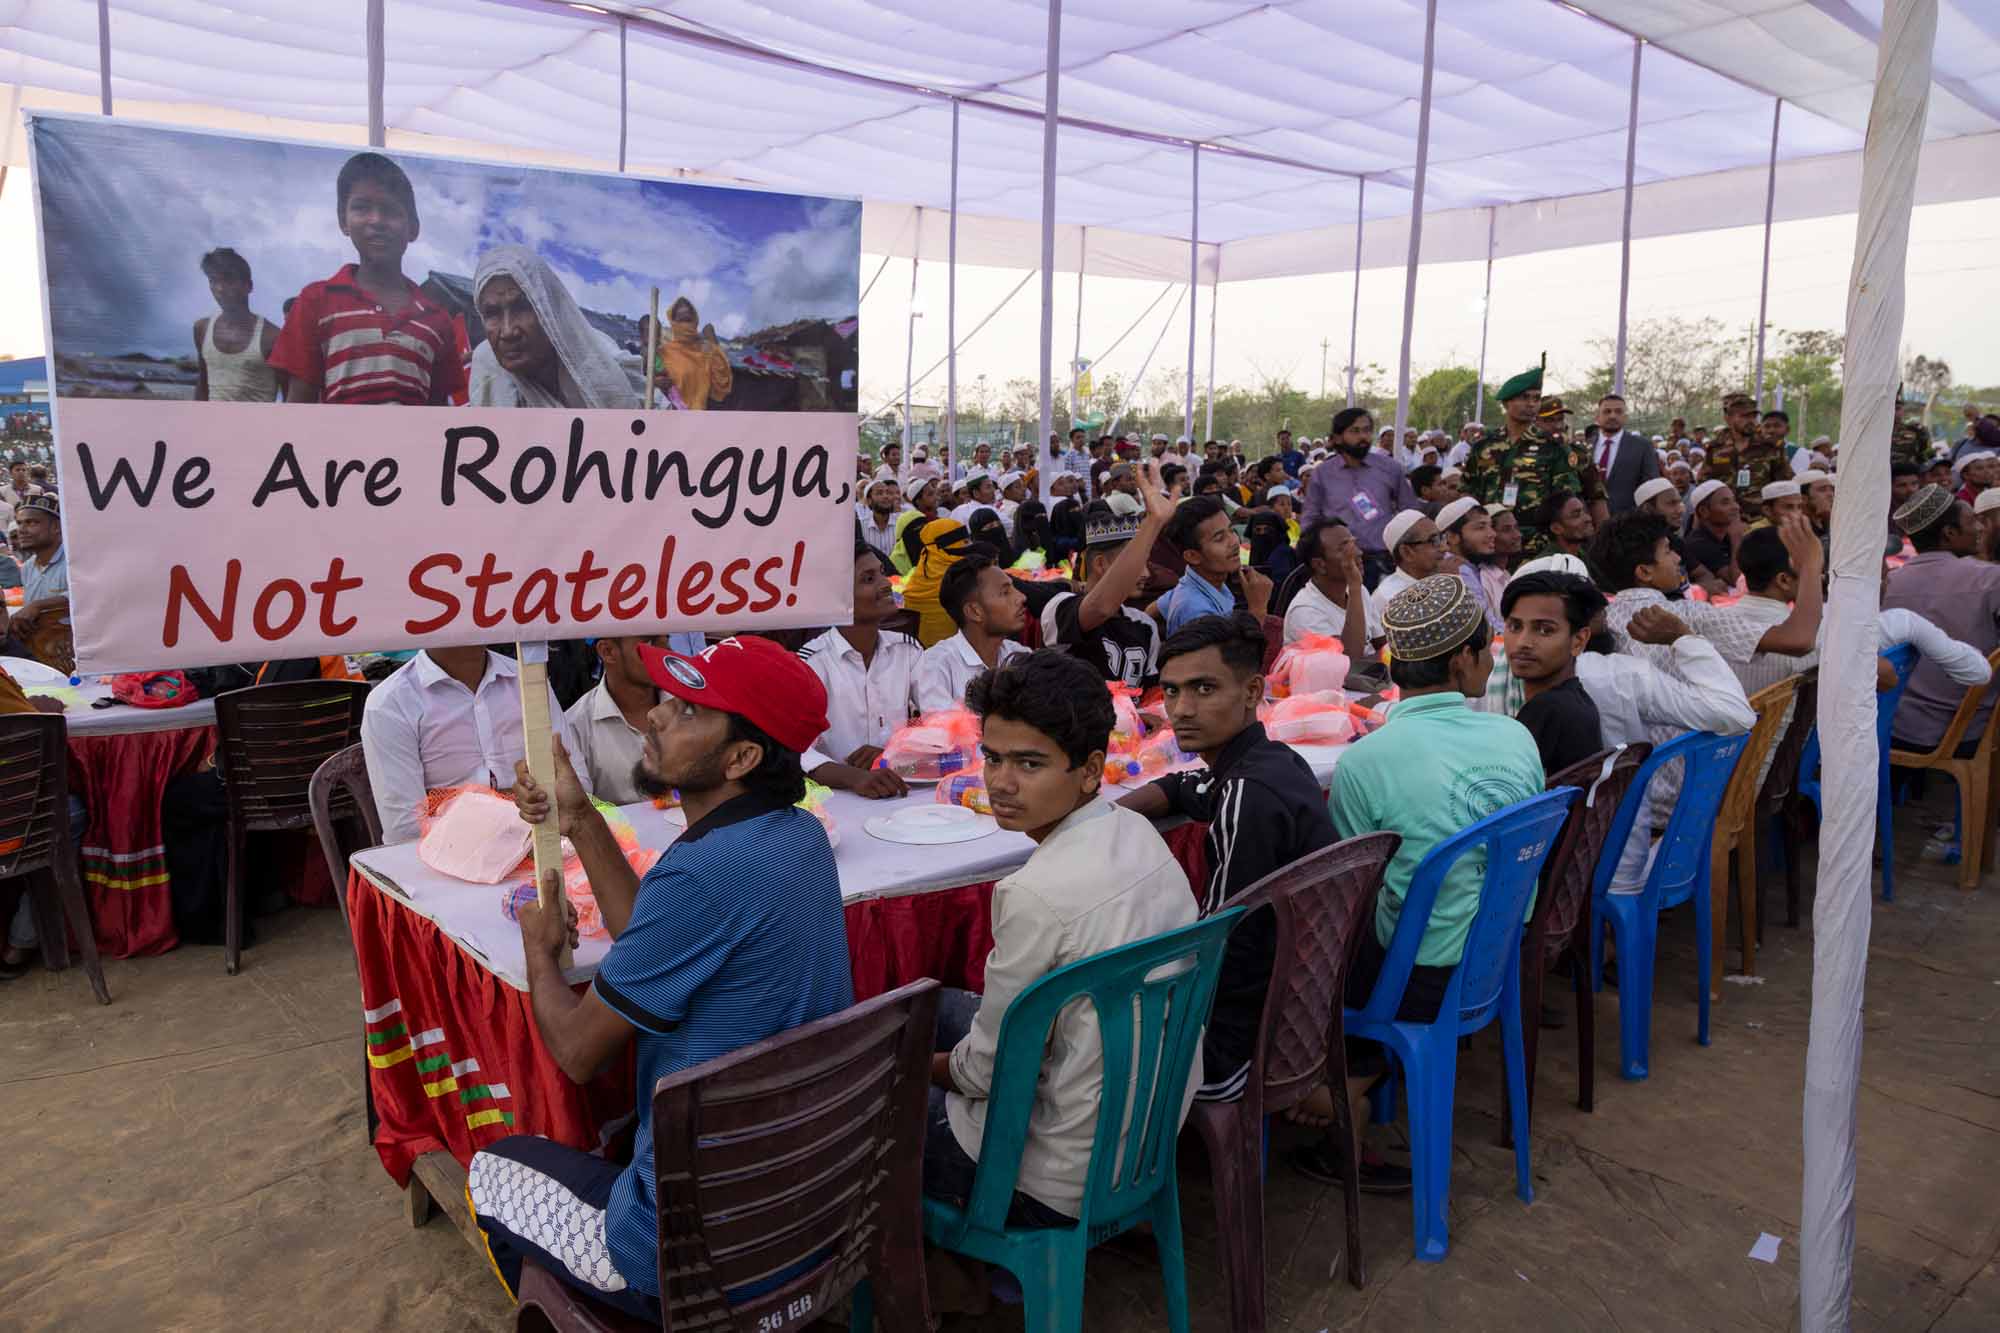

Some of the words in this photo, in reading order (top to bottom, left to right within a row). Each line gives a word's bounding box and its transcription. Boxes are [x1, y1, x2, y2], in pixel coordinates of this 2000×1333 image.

[76, 440, 215, 511] We
[251, 442, 402, 508] Are
[440, 417, 851, 529] Rohingya,
[163, 557, 363, 647] Not
[404, 536, 805, 635] Stateless!
